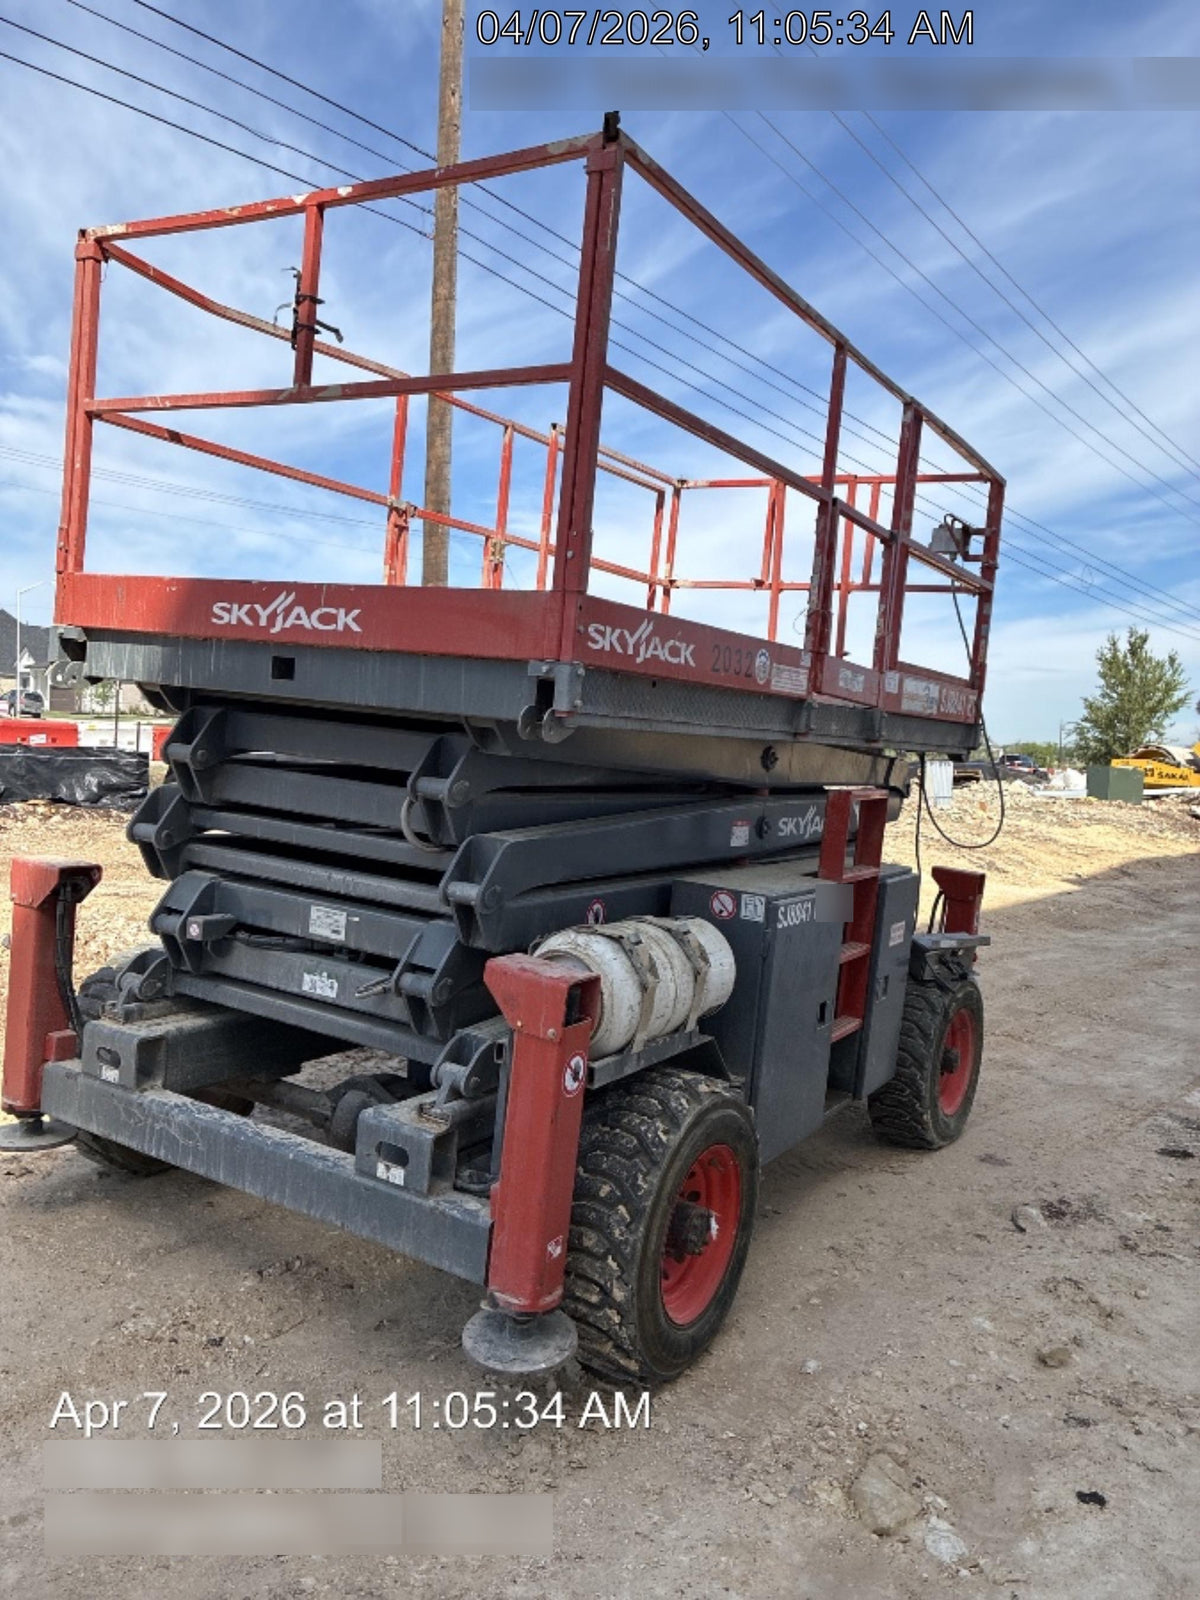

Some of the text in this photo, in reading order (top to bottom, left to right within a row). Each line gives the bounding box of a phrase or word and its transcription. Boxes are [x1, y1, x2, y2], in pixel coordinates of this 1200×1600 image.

[211, 591, 362, 634] SKYJACK
[587, 618, 696, 667] SKYJACK
[711, 644, 754, 678] 2032
[778, 805, 824, 839] SKYJA
